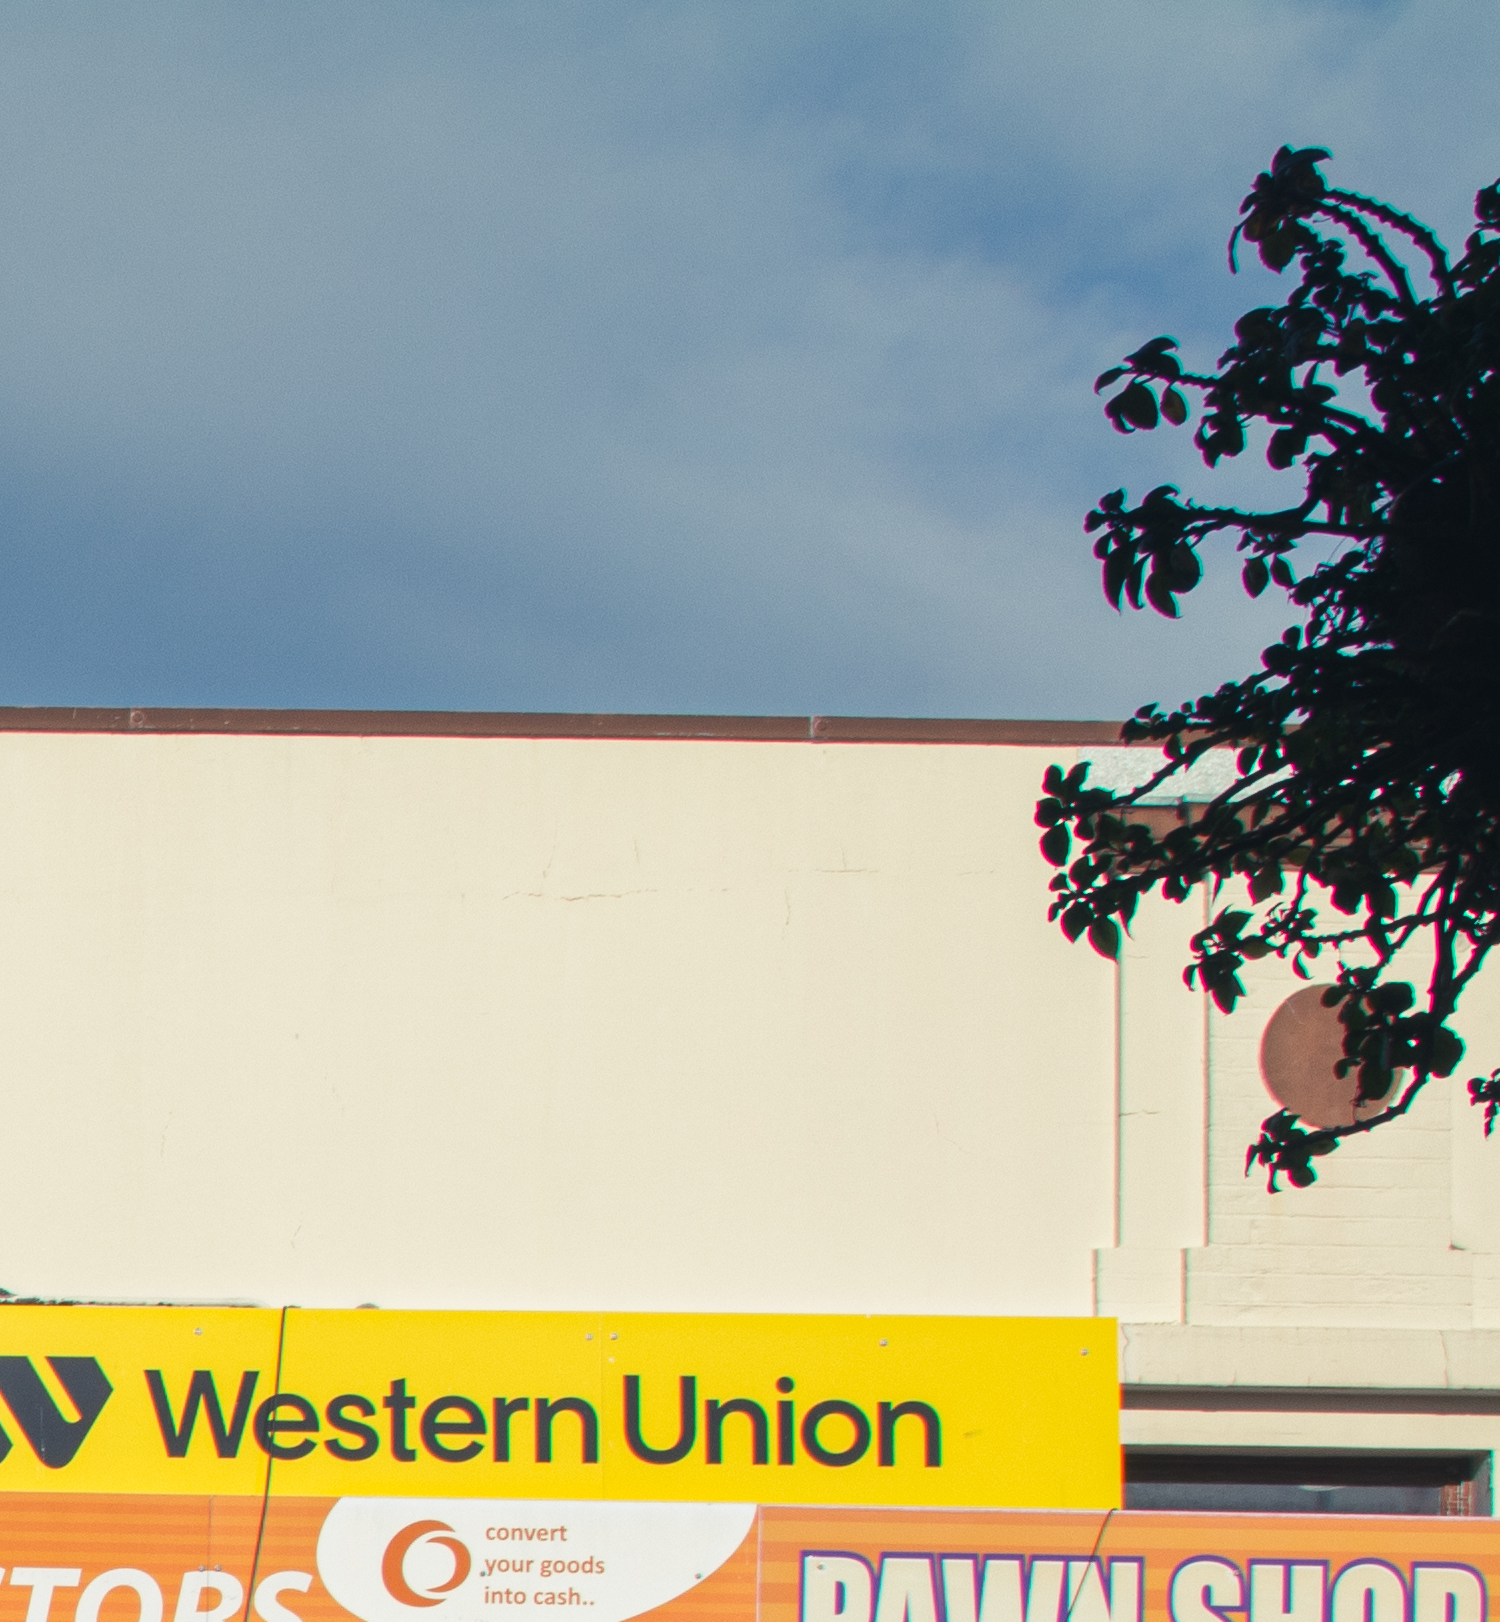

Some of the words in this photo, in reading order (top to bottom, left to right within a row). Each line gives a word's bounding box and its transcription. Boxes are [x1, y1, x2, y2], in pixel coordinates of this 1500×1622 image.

[145, 1368, 601, 1466] Western
[622, 1373, 943, 1468] Union
[485, 1523, 569, 1545] convert
[484, 1556, 535, 1582] your
[539, 1554, 606, 1581] goods
[484, 1586, 527, 1607] into
[532, 1585, 597, 1608] cash..
